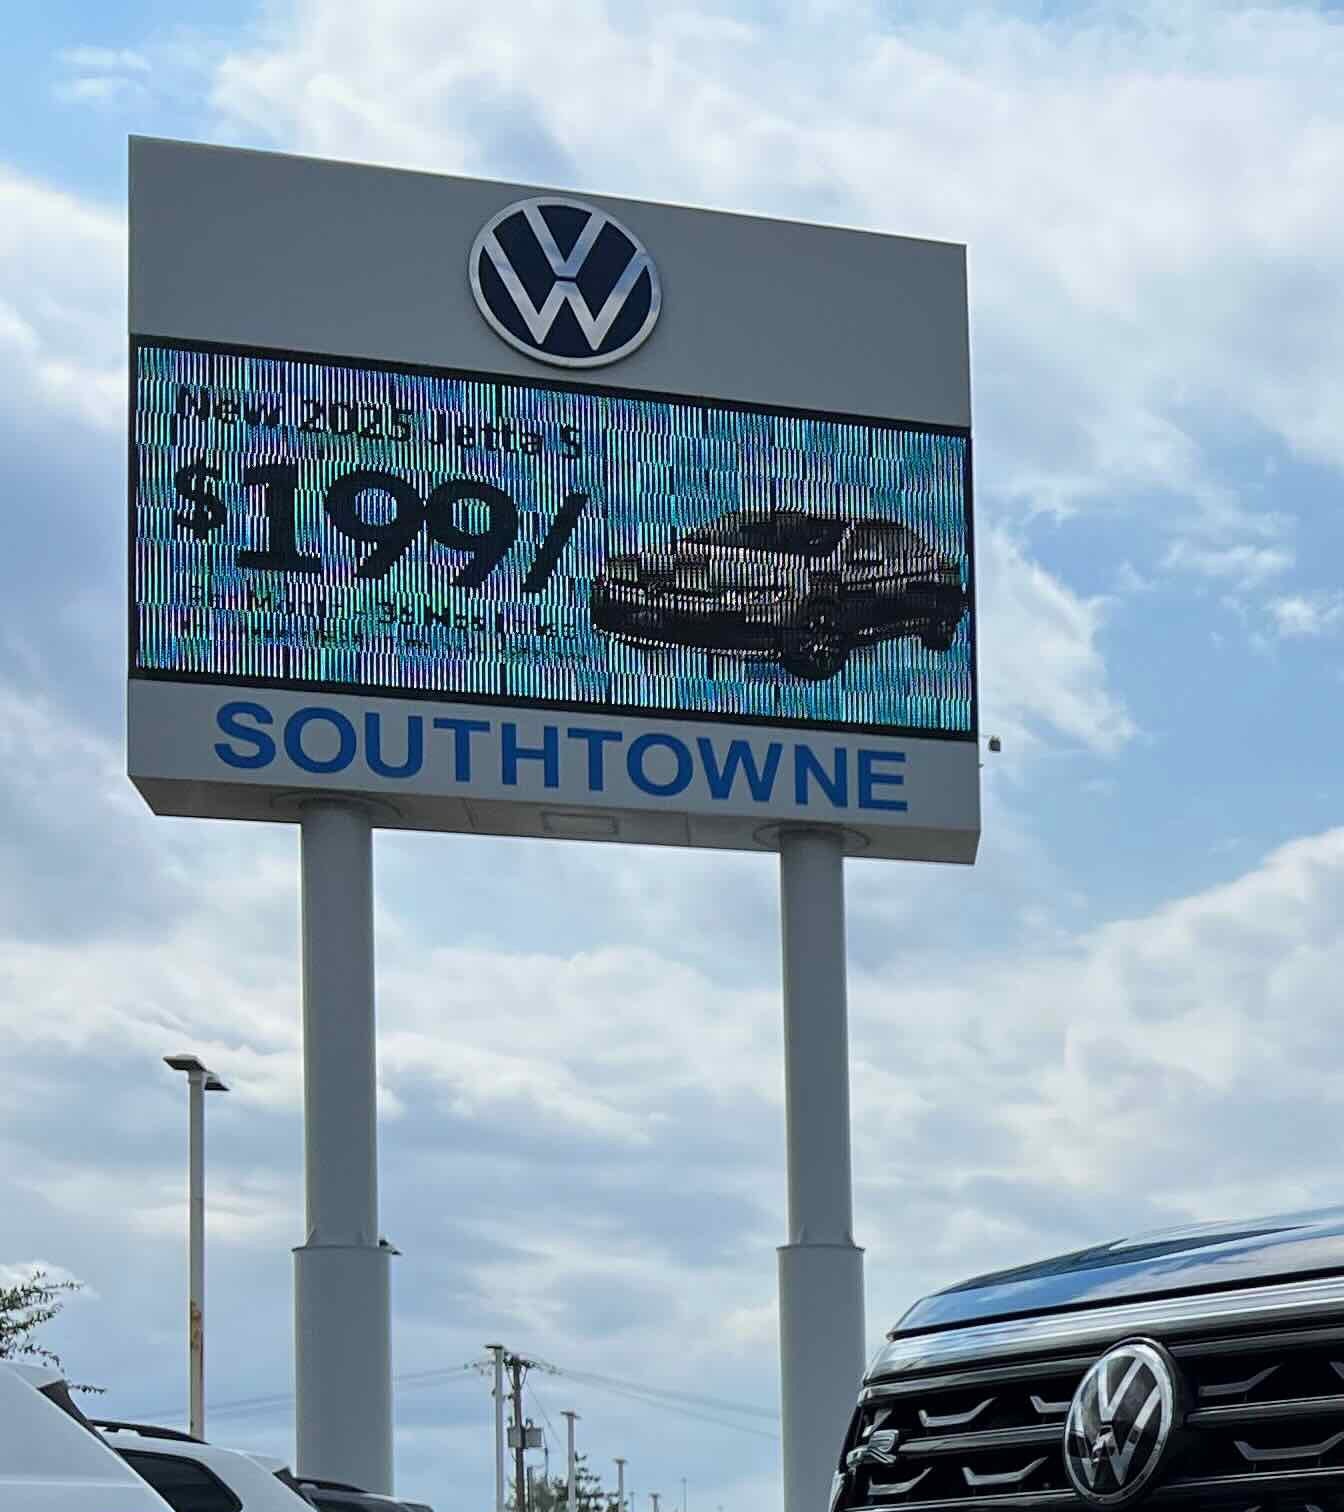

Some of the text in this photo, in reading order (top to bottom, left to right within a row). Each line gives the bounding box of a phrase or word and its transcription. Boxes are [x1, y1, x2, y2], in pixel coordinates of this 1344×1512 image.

[178, 386, 582, 460] New 2025 Jetta S
[212, 700, 909, 813] SOUTHTOWNE
